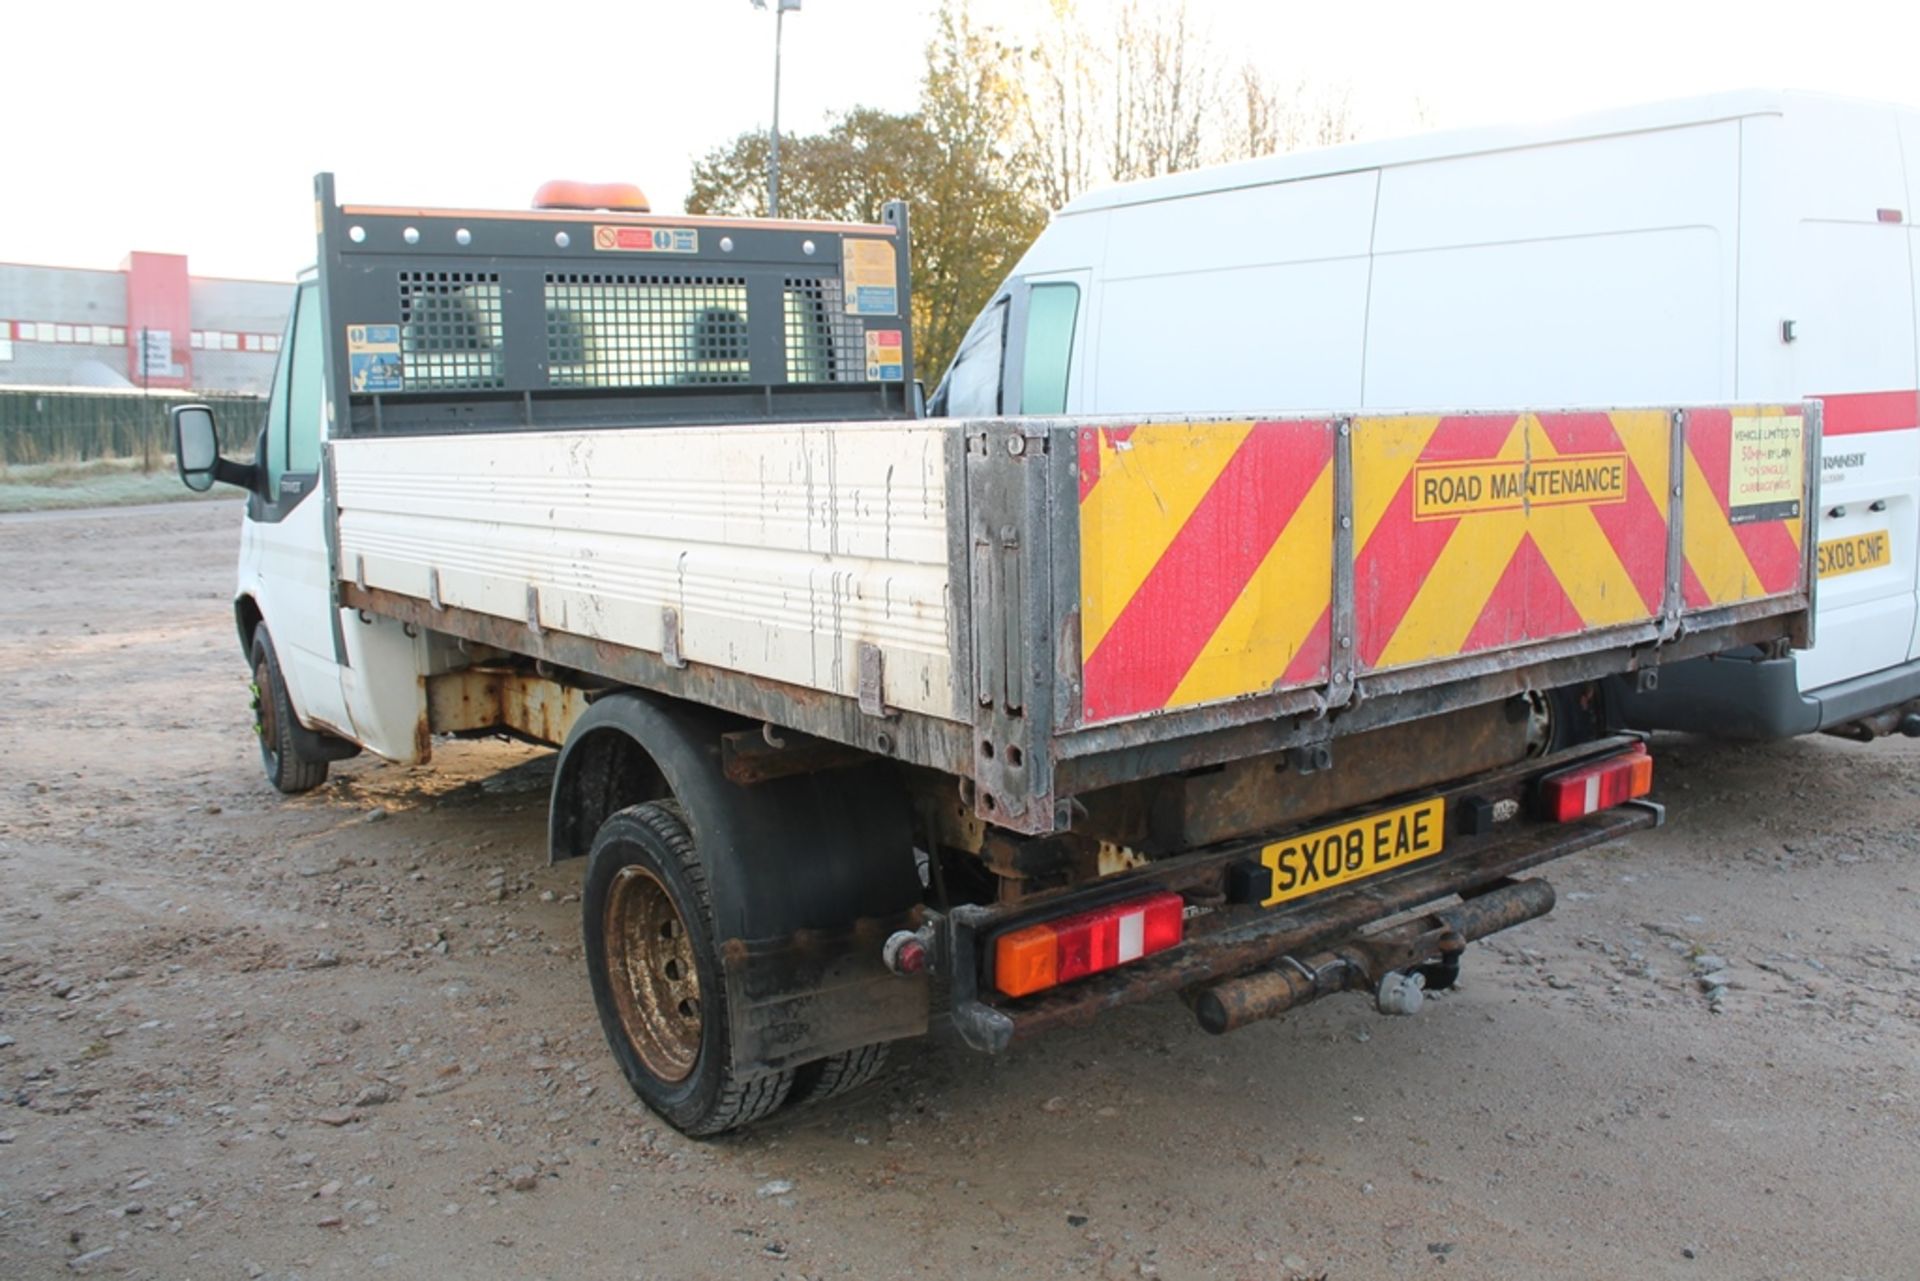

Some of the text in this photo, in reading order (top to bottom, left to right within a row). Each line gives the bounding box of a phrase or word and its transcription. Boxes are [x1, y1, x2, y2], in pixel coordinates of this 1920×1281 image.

[1763, 427, 1789, 440] LIMITED
[1822, 452, 1866, 470] TRANSIT
[1424, 466, 1621, 505] ROAD MAINTENANCE
[1818, 535, 1883, 573] SX08 CNF
[1278, 808, 1431, 891] SX08 EAE
